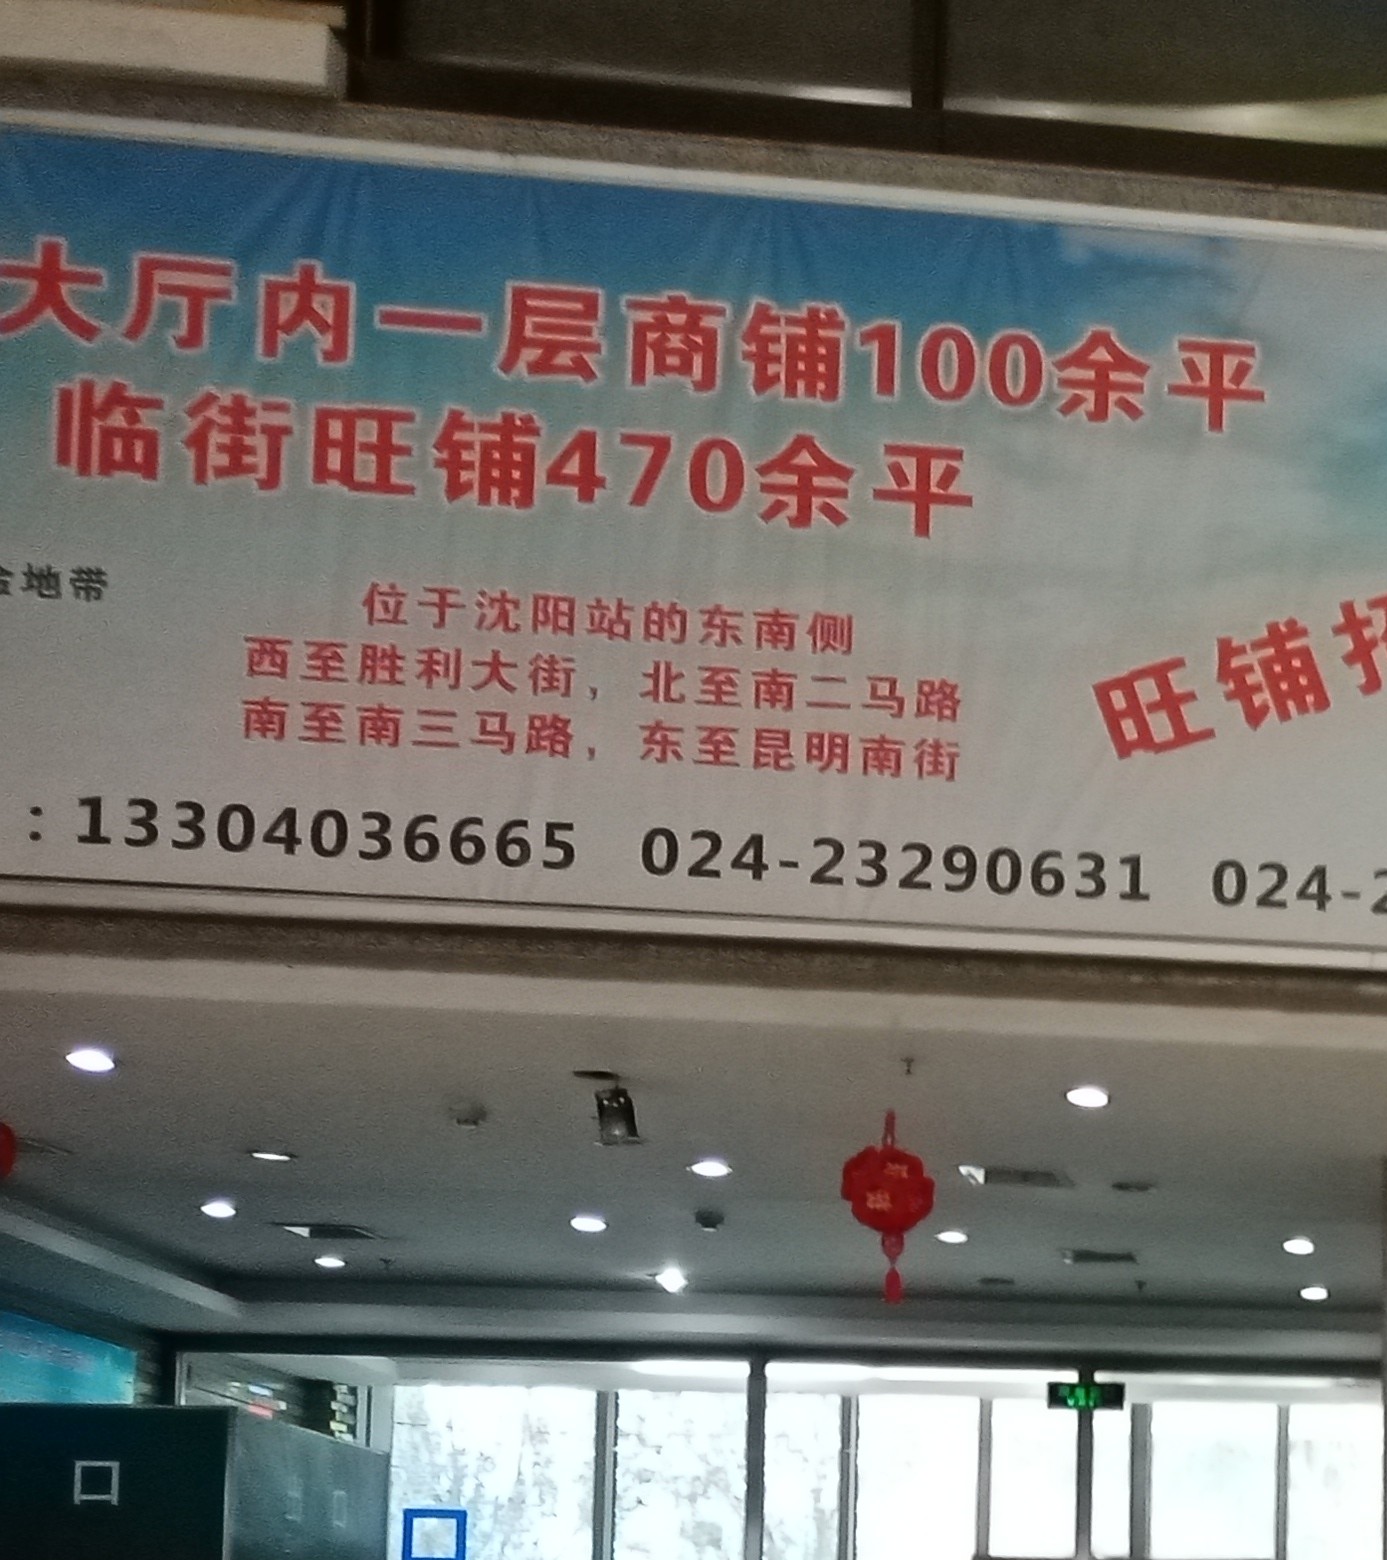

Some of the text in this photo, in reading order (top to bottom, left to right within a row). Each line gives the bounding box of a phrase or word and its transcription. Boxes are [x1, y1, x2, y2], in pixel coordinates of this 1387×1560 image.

[0, 238, 1266, 433] 大厅内一层商铺100余平
[55, 379, 974, 538] 临街旺铺470余平
[362, 582, 855, 655] 位于沈阳站的东南侧
[641, 827, 1153, 903] 024-23290631
